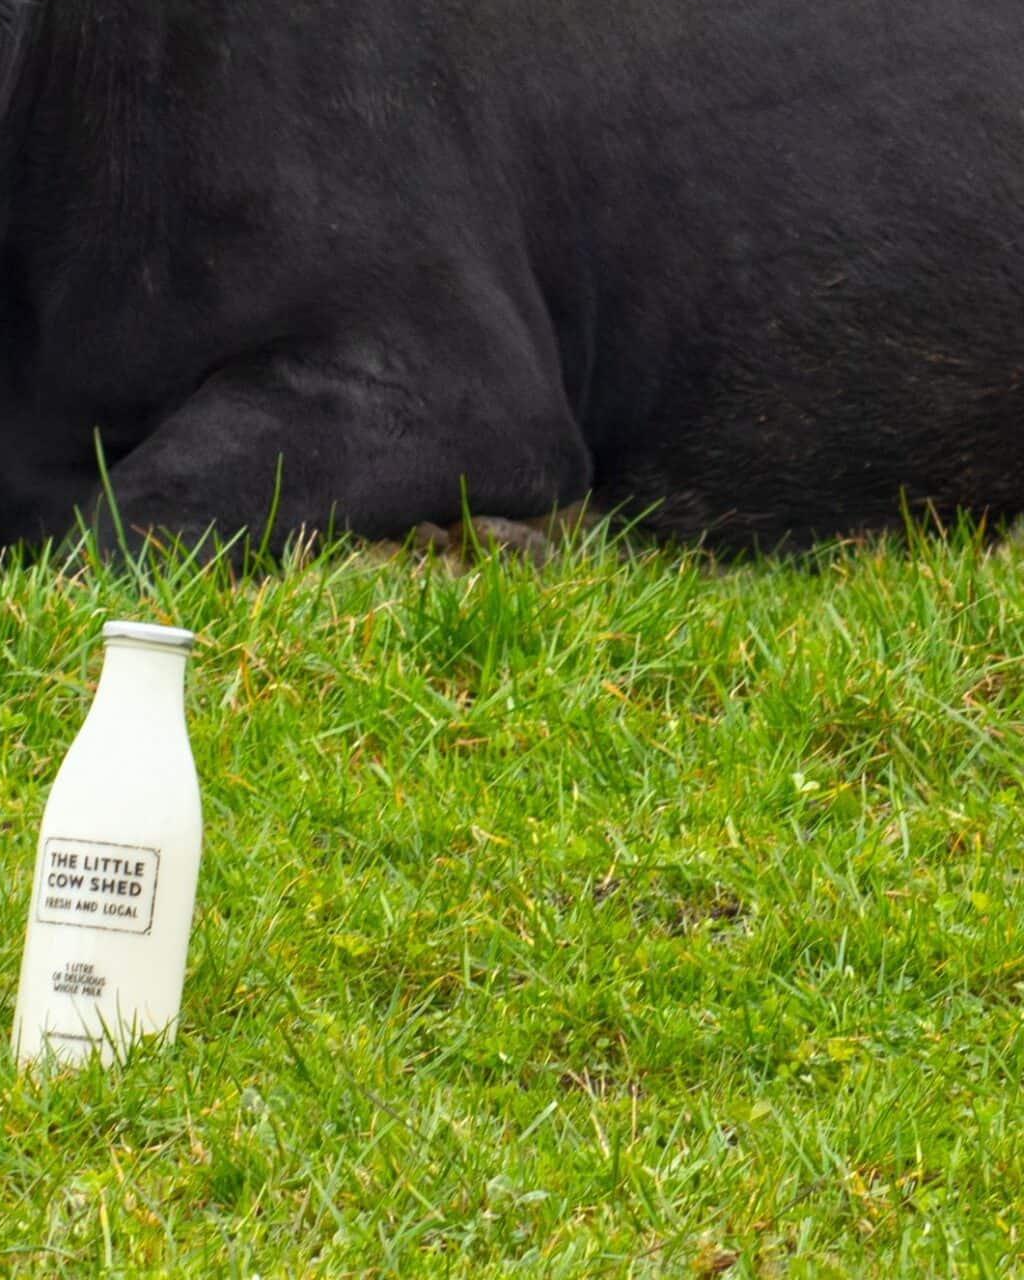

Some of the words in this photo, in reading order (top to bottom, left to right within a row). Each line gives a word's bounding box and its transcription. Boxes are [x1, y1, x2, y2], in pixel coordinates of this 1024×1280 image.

[51, 852, 78, 869] THE
[83, 855, 145, 877] LITTLE
[47, 873, 84, 889] COW
[89, 877, 142, 897] SHED
[45, 896, 72, 910] FRESH
[75, 900, 98, 913] AND
[102, 903, 138, 919] LOCAL
